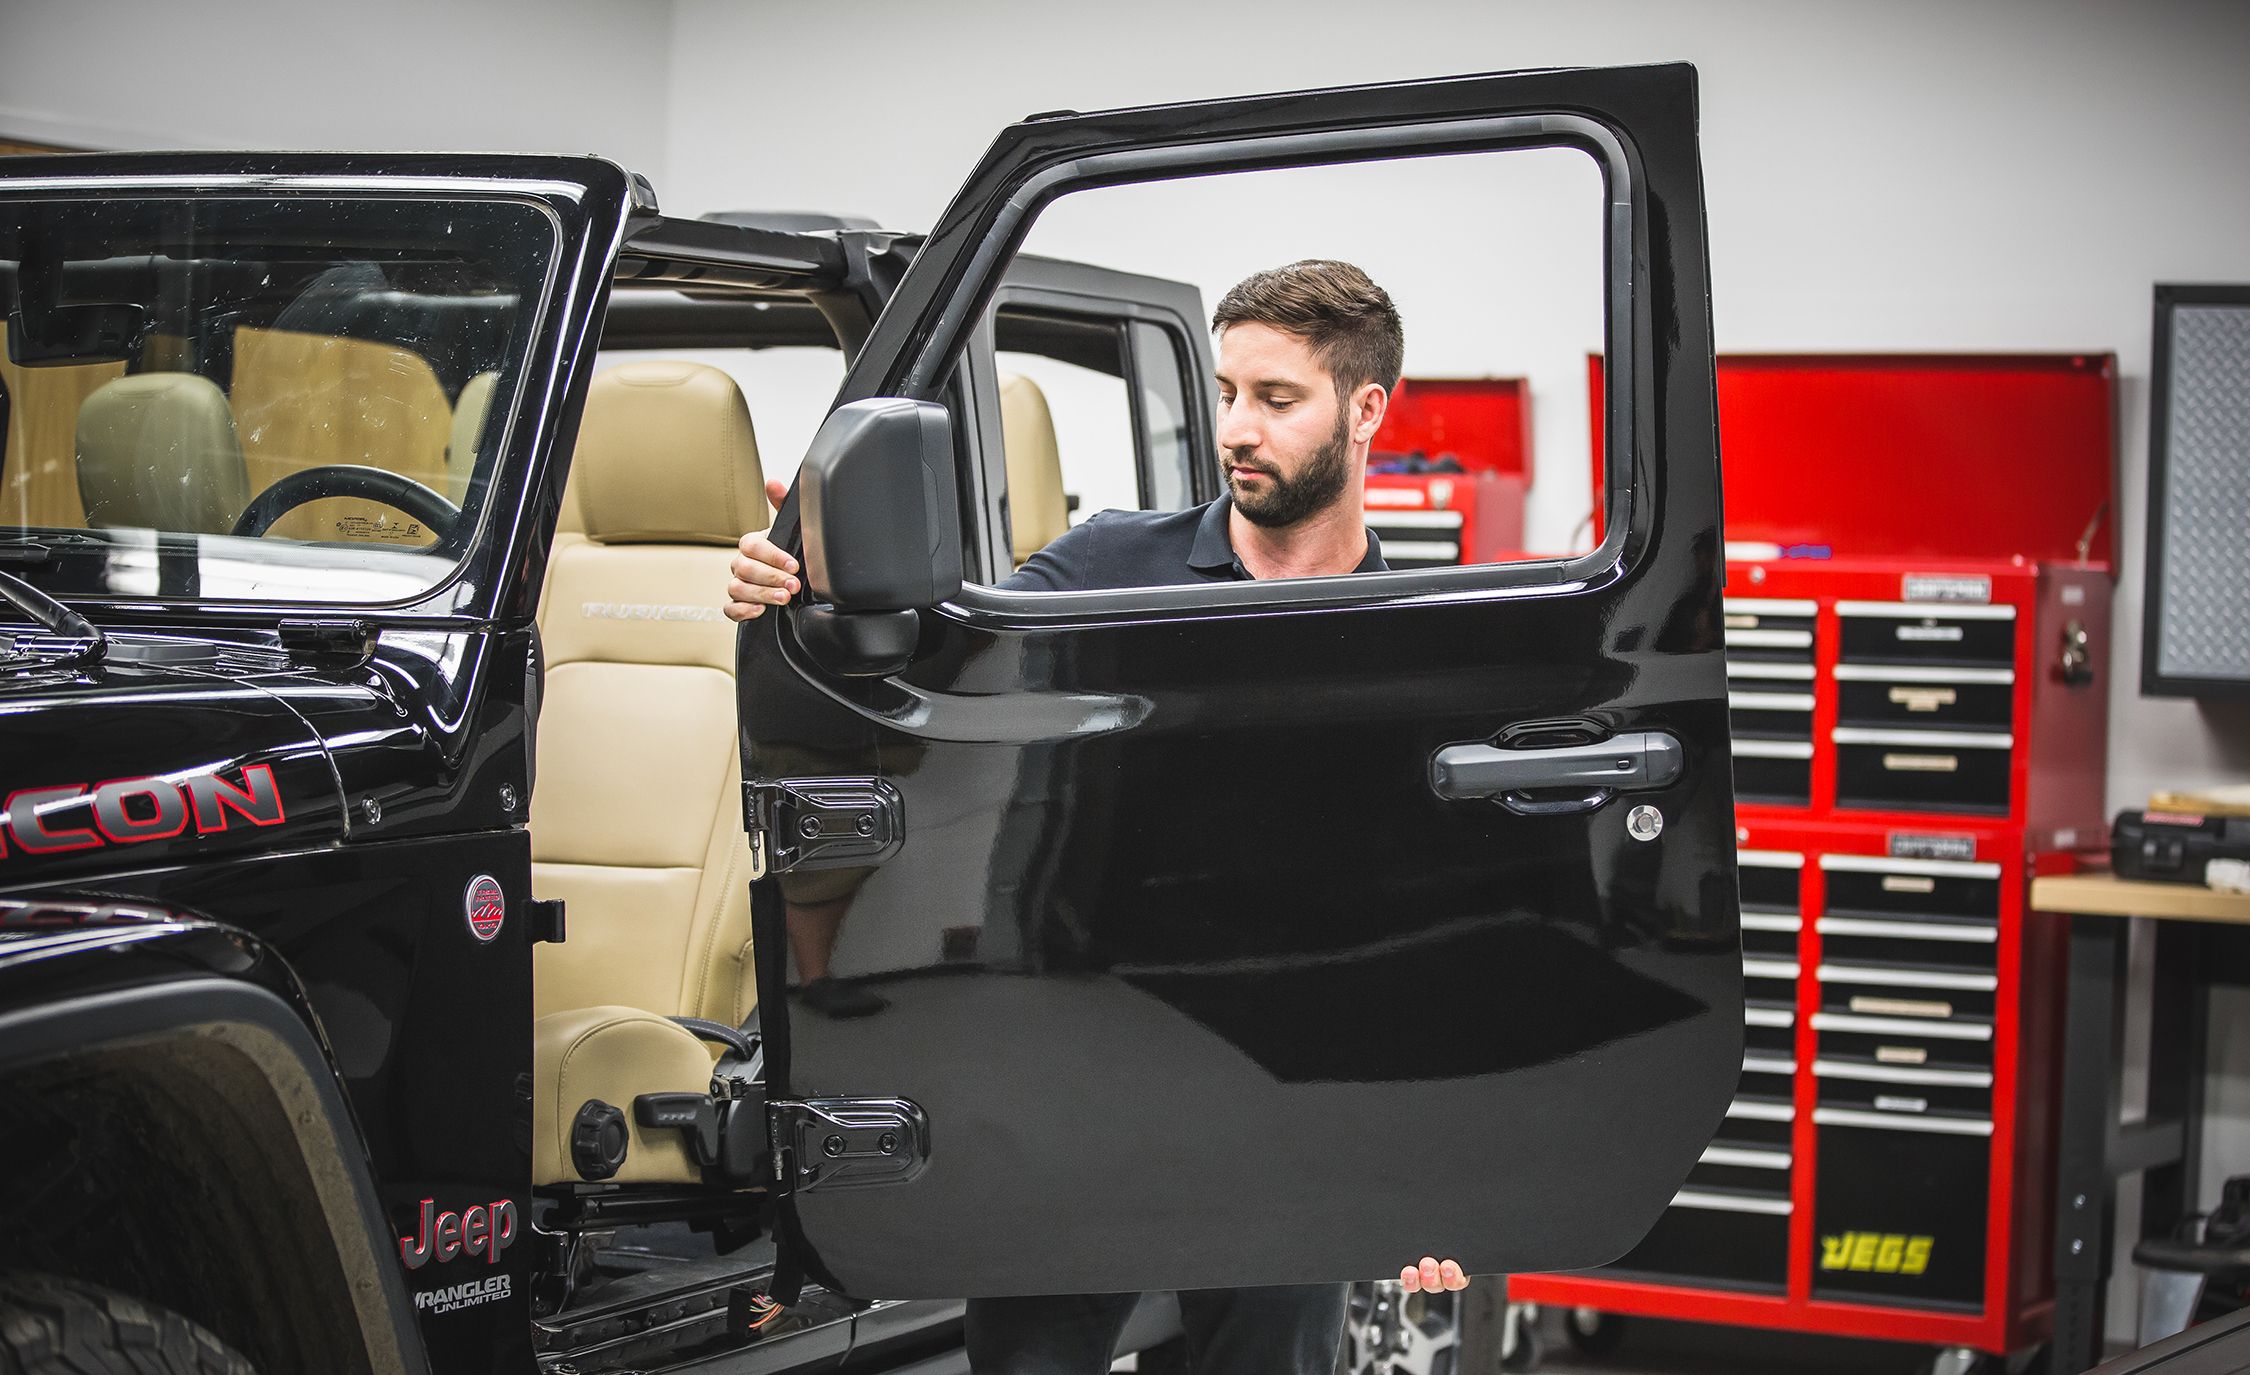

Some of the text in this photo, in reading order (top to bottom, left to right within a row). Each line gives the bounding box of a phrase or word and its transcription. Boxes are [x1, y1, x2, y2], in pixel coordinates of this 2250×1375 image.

[582, 603, 725, 622] RUBICON
[0, 763, 285, 859] CON
[400, 1198, 518, 1269] Jeep
[1821, 1231, 1934, 1274] JEGS
[434, 1289, 511, 1314] UNLIMITED
